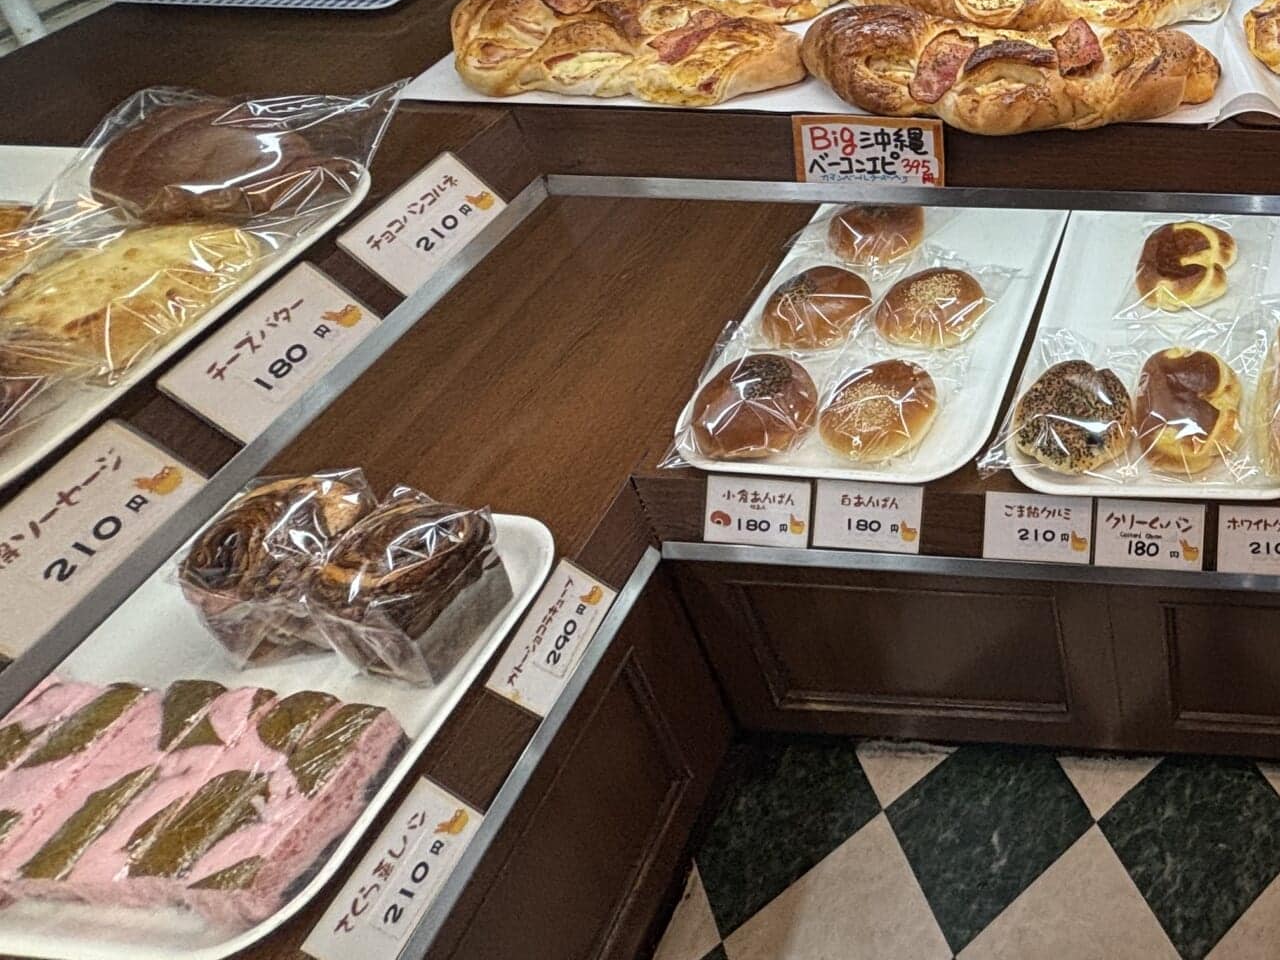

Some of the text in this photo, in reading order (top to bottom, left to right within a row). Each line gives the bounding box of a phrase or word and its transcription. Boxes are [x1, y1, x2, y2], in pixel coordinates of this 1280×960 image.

[809, 152, 901, 175] ベーコンエピ
[207, 298, 304, 381] チーズバター
